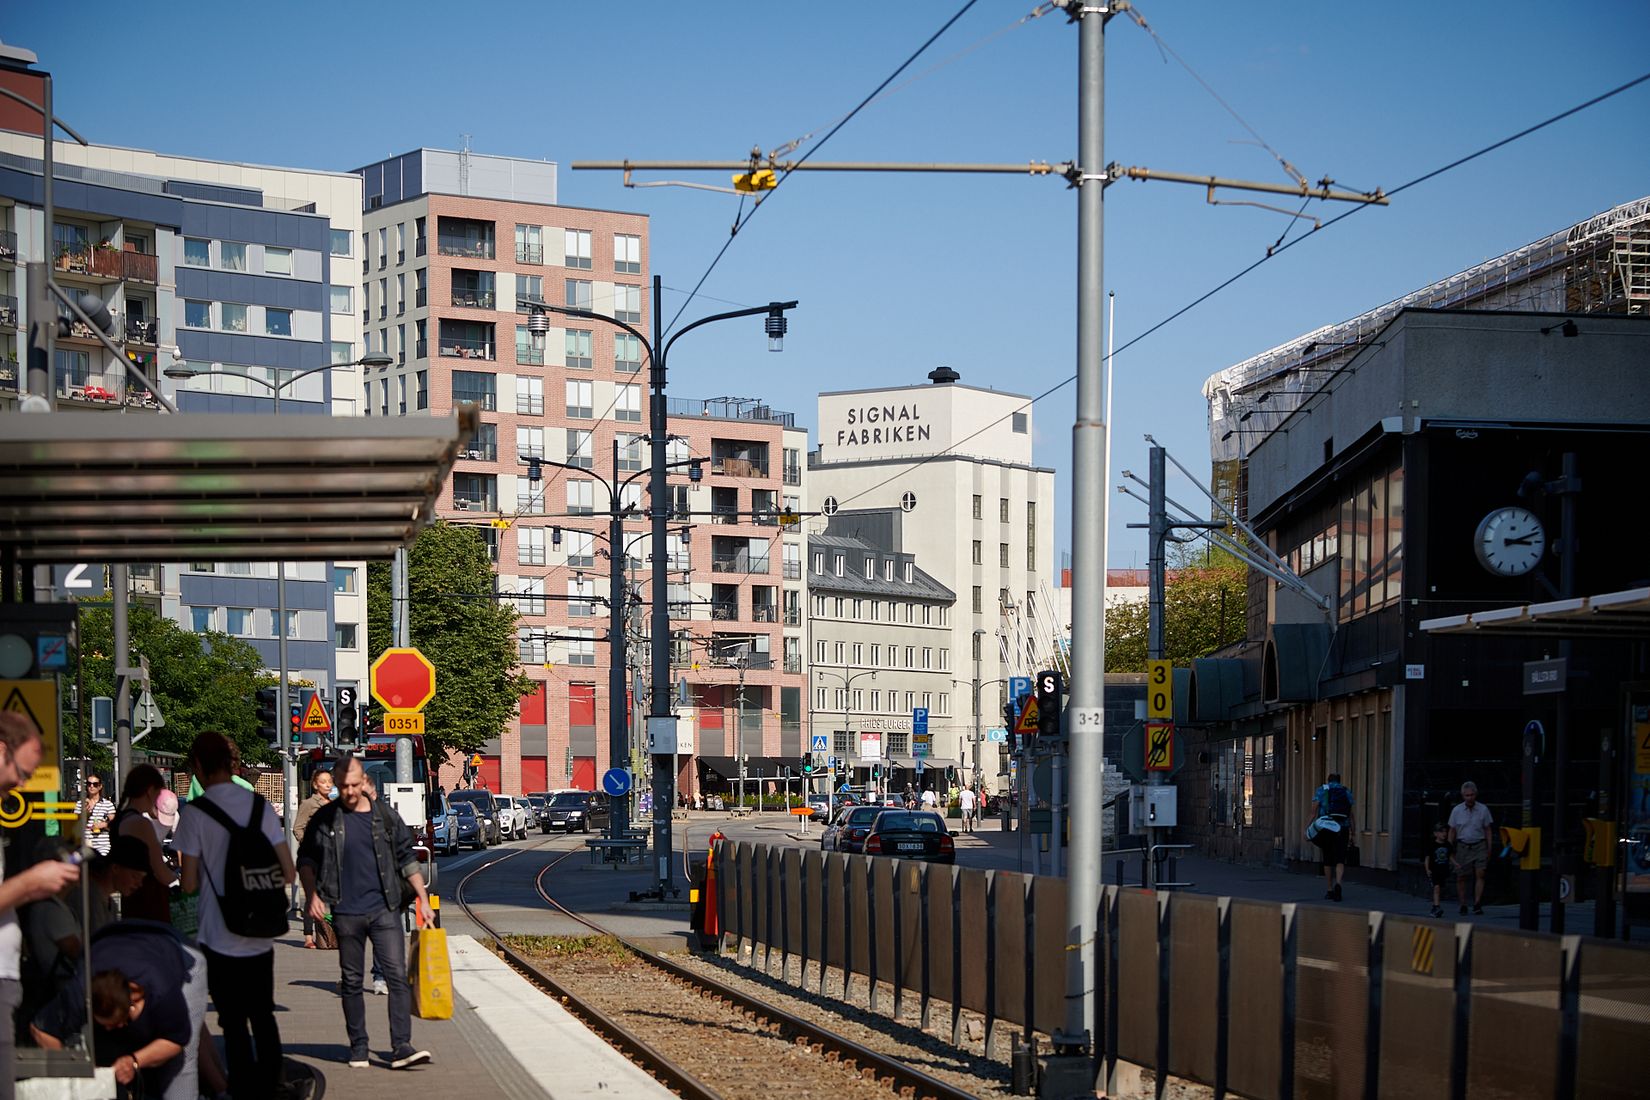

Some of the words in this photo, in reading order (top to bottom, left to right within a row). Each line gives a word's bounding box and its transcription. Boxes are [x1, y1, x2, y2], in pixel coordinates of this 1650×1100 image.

[847, 403, 920, 425] SIGNAL
[837, 424, 930, 446] FABRIKEN
[1014, 679, 1027, 696] P
[1043, 676, 1055, 693] S
[340, 689, 351, 705] S
[916, 709, 926, 721] P
[389, 718, 418, 730] 0351
[883, 718, 912, 730] BURGER
